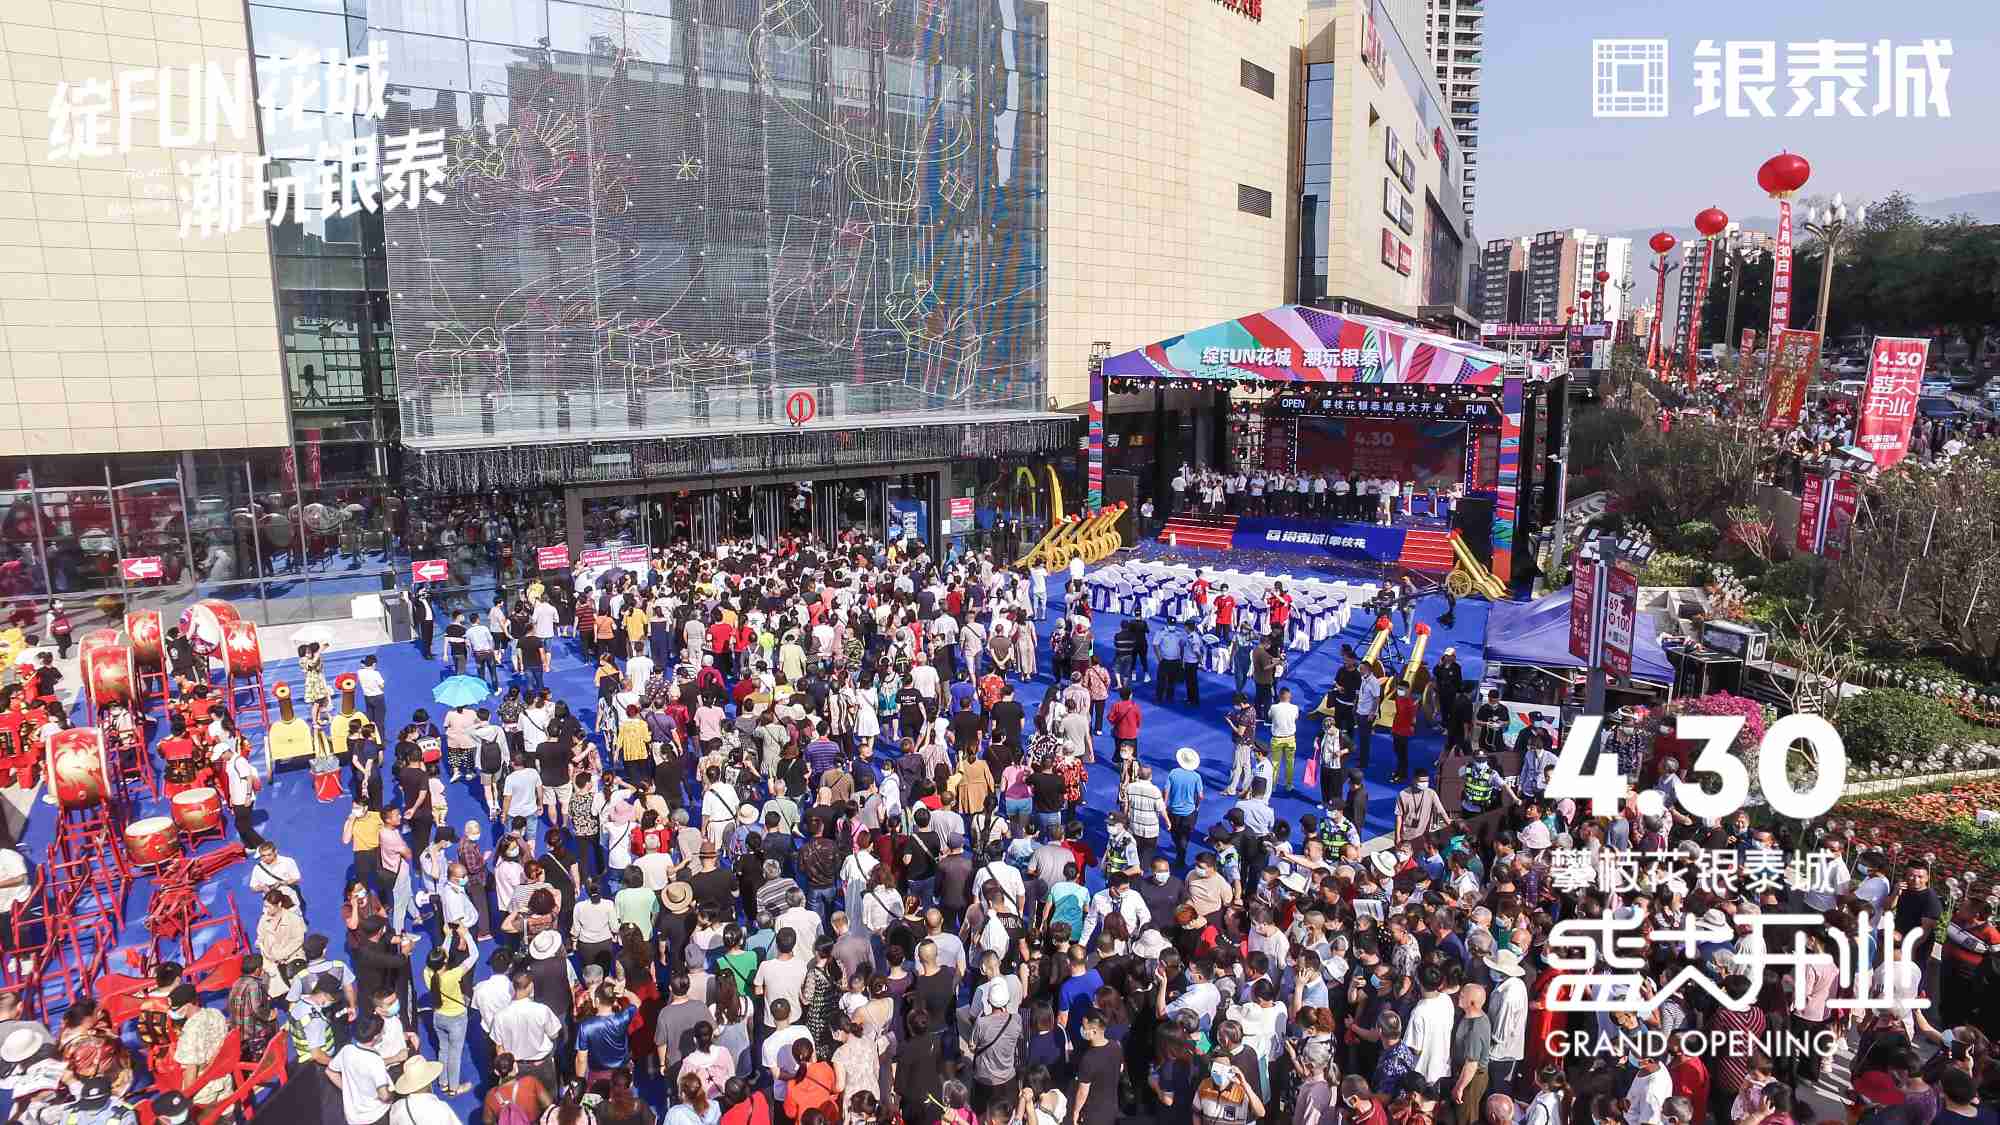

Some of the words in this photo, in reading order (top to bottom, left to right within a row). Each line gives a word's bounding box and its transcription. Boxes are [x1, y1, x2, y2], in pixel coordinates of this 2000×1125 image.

[1202, 346, 1291, 367] 绽FUN花城
[1303, 348, 1380, 369] 潮玩银泰
[1878, 352, 1922, 366] 4.30
[1281, 399, 1306, 409] OPEN
[1465, 404, 1487, 416] FUN
[1354, 431, 1394, 447] 4.30
